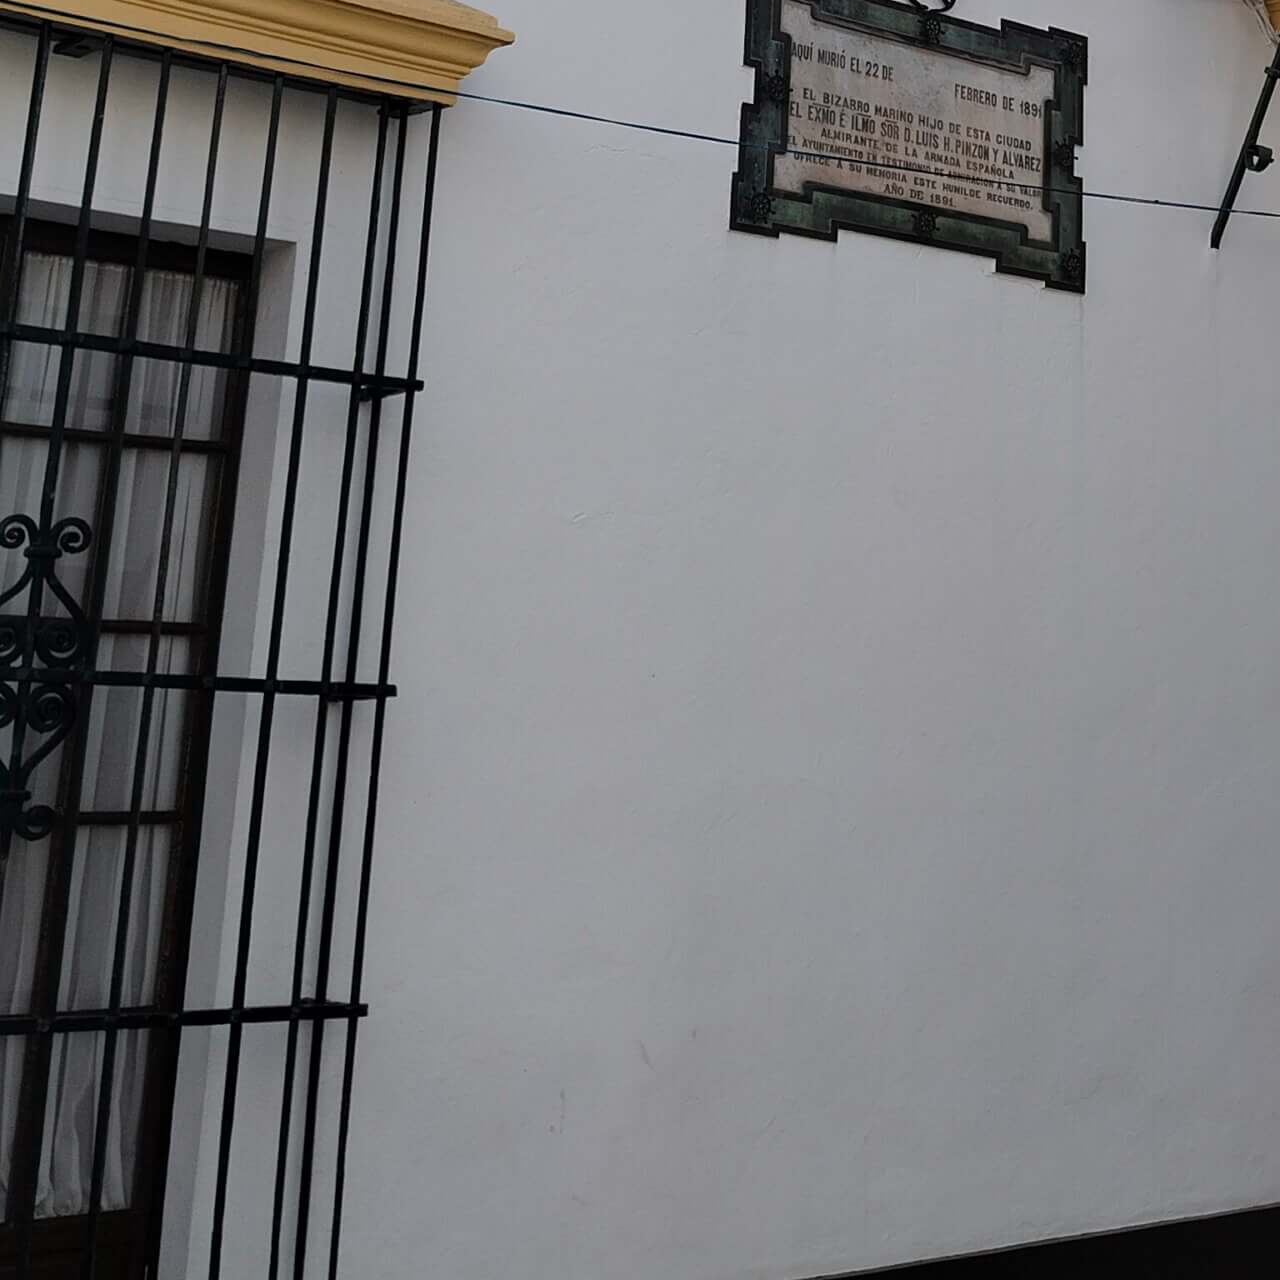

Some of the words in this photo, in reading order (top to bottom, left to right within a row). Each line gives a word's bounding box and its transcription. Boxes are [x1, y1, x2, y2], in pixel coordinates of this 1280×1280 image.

[817, 49, 846, 69] MURIÓ
[850, 57, 862, 74] EL
[865, 61, 880, 78] 22
[882, 65, 894, 82] DE
[954, 83, 998, 108] FEBRERO
[1002, 95, 1015, 112] DE
[1020, 100, 1042, 119] 1891
[789, 101, 802, 118] EL
[880, 122, 899, 140] SOR
[992, 148, 999, 163] Y
[1002, 150, 1041, 173] ALVAREZ
[803, 87, 816, 101] EL
[823, 92, 870, 113] BIZARRO
[874, 104, 914, 124] MARINO
[918, 115, 943, 131] HIJO
[949, 122, 961, 135] DE
[966, 127, 991, 142] ESTA
[996, 134, 1032, 152] CIUDAD
[802, 138, 864, 159] AYUNTAMIENTO
[866, 152, 877, 162] EN
[885, 142, 898, 153] DE
[905, 146, 918, 159] LA
[924, 151, 961, 168] ARMADA
[966, 160, 1015, 180] ESPAÑOLA
[849, 163, 862, 174] SU
[866, 165, 907, 183] MEMORIA
[914, 176, 937, 189] ESTE
[942, 182, 982, 200] HUMILDE
[884, 182, 904, 196] AÑO
[910, 189, 924, 201] DE
